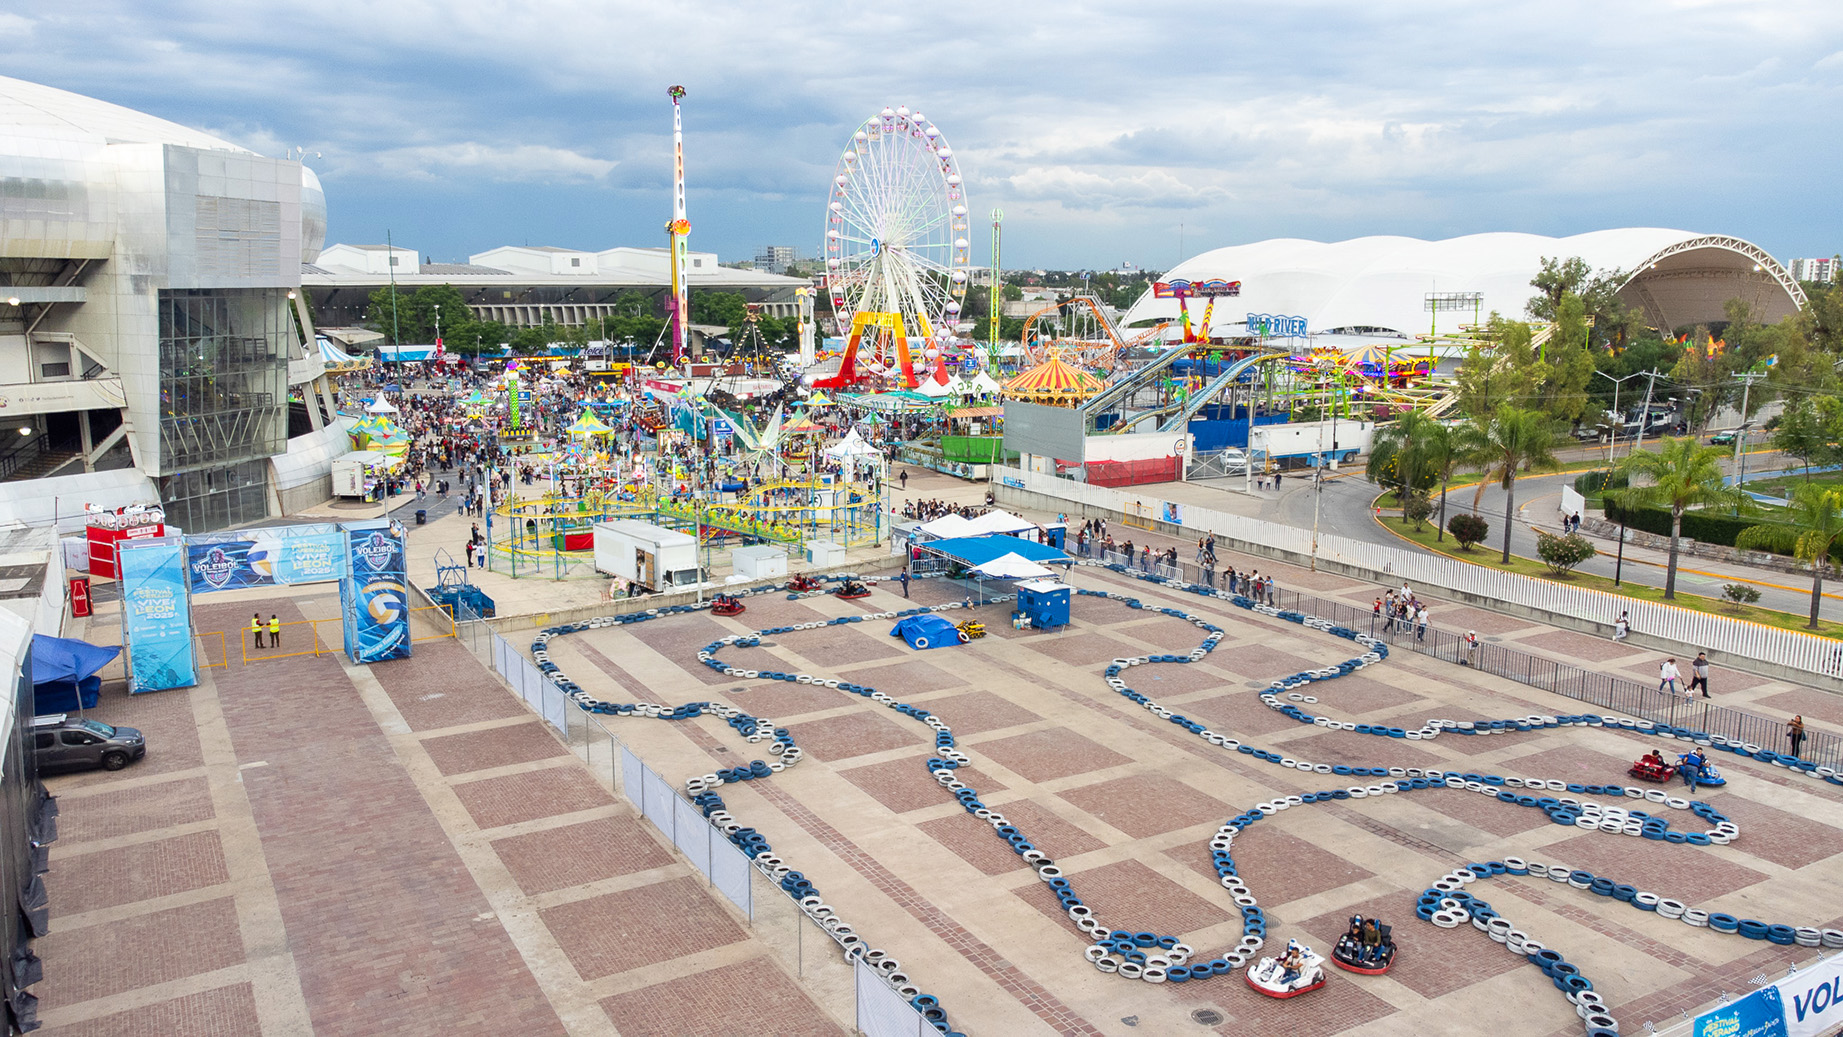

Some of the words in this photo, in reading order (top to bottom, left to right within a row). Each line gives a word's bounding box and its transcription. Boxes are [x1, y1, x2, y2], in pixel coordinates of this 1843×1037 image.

[1274, 318, 1306, 335] RIVER
[291, 543, 330, 551] FESTIVAL
[357, 546, 397, 555] VOLEIBOL
[295, 553, 328, 561] VIVE
[193, 562, 240, 573] VOLEIBOL
[303, 567, 331, 575] 2025
[133, 589, 174, 597] FESTIVAL
[137, 598, 171, 607] VIVE
[146, 612, 174, 620] 2025
[1793, 976, 1843, 1023] VOL
[1702, 1016, 1740, 1037] FESTIVAL
[1707, 1023, 1741, 1037] VERANO
